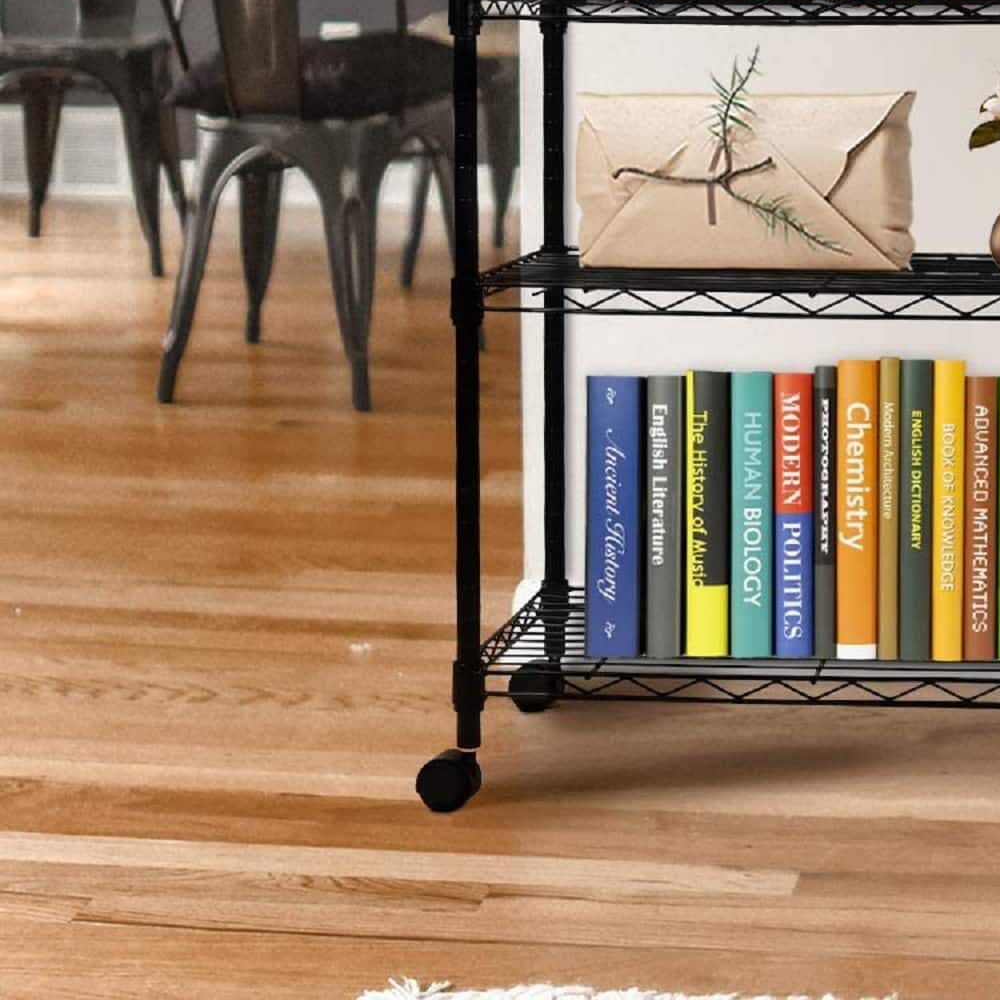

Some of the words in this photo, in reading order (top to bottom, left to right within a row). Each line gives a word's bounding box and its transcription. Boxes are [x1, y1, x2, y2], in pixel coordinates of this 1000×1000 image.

[650, 403, 668, 470] English
[693, 410, 708, 444] The
[744, 412, 761, 500] HUMAN
[781, 392, 802, 505] MODERN
[883, 402, 894, 446] Modern
[911, 410, 922, 467] ENGLISH
[941, 424, 955, 466] BOOK
[973, 405, 989, 502] ADVANCED
[604, 428, 626, 517] Ancient
[692, 450, 708, 514] History
[838, 402, 873, 552] Chemistry
[882, 449, 893, 520] Architecture
[911, 470, 922, 550] DICTIONARY
[941, 471, 955, 492] OF
[597, 517, 625, 606] History
[652, 476, 668, 566] Literature
[692, 537, 708, 587] Music
[693, 515, 707, 536] of
[744, 508, 762, 607] BIOLOGY
[940, 497, 955, 592] KNOWLEDGE
[783, 522, 803, 640] POLITICS
[971, 508, 988, 633] MATHEMATICS
